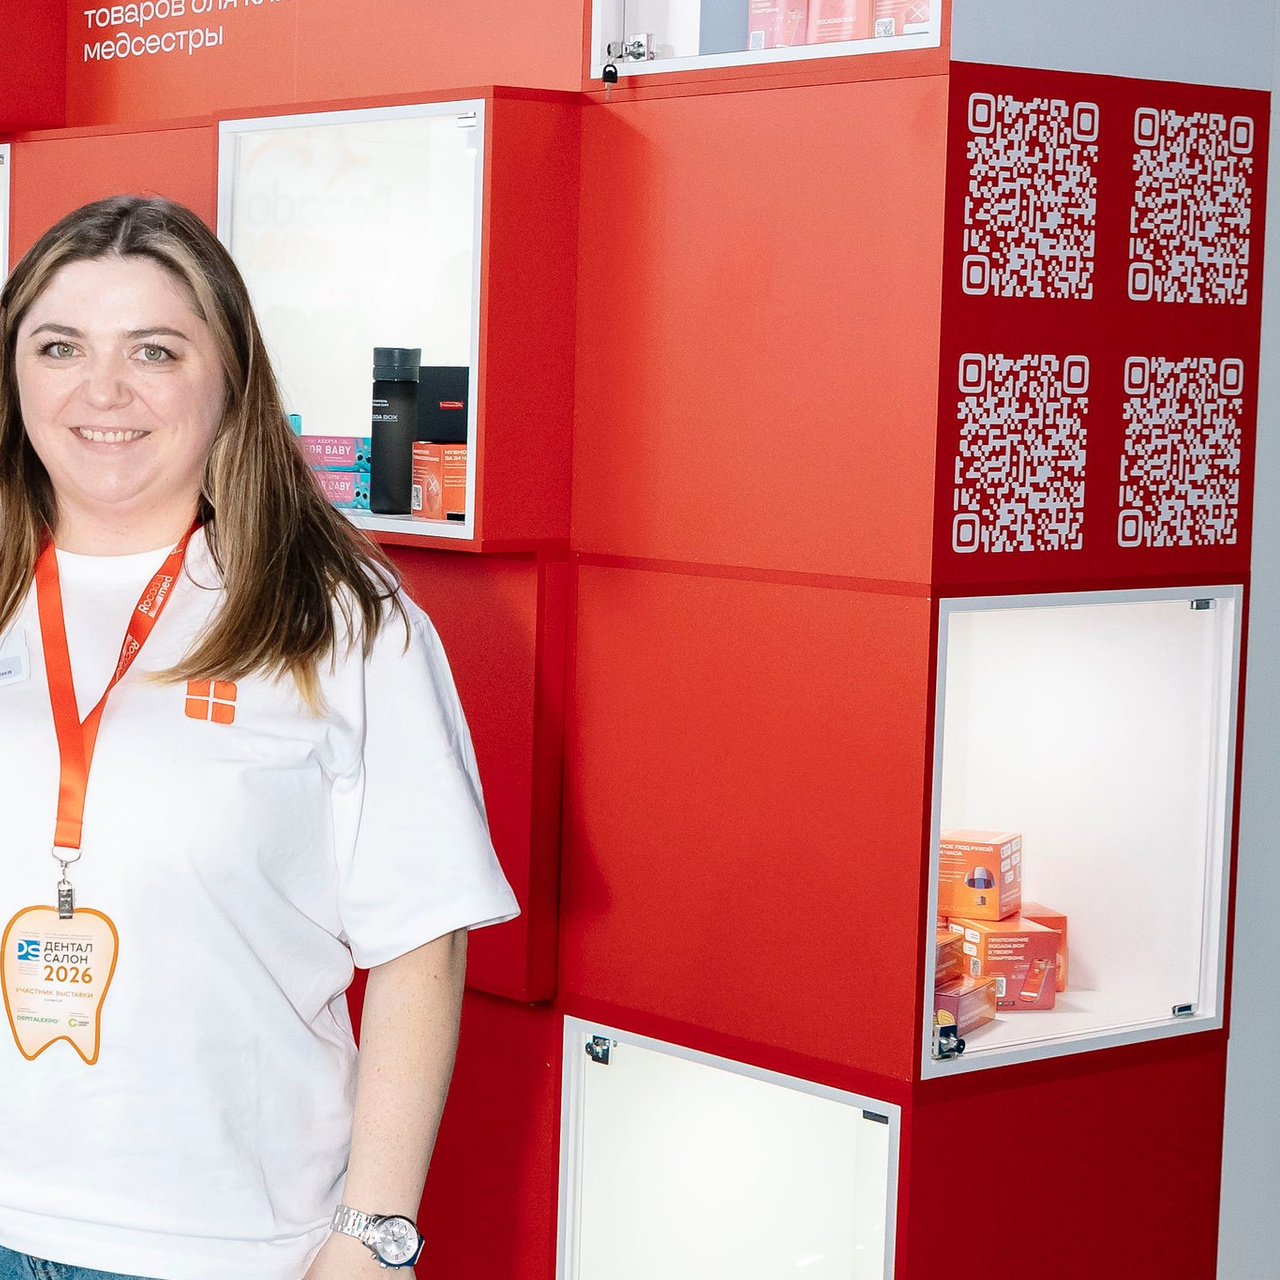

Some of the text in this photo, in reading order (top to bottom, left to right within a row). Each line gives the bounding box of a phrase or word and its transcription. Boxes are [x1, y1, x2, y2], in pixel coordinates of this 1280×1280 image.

[84, 20, 224, 64] медсестры
[325, 445, 351, 455] BABY
[138, 575, 164, 614] Rocada
[158, 576, 173, 601] med
[43, 941, 93, 953] ДЕНТАЛ
[43, 953, 89, 964] САЛОН
[44, 965, 93, 984] 2026
[15, 986, 94, 999] УЧАСТНИК ВЫСТАВКИ
